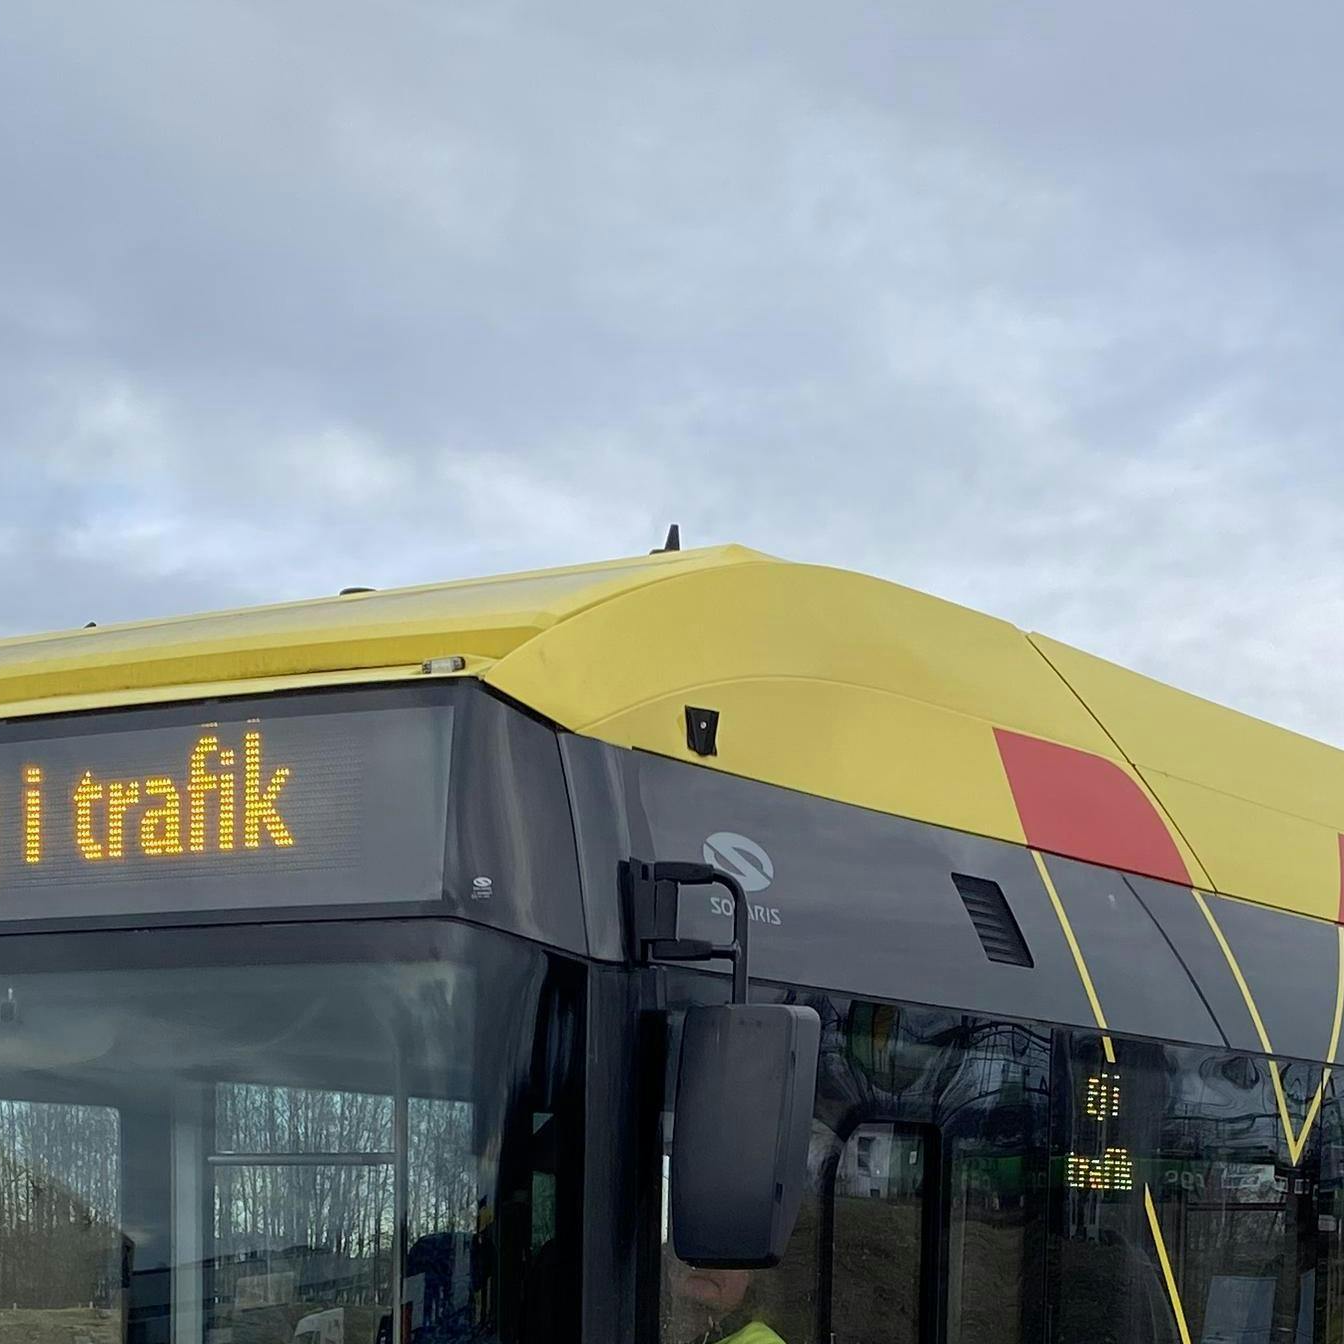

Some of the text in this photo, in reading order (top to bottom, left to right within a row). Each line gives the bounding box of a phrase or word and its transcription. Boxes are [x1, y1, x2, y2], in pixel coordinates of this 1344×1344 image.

[26, 768, 41, 862] i
[72, 733, 294, 860] trafik
[709, 896, 782, 926] SOARIS
